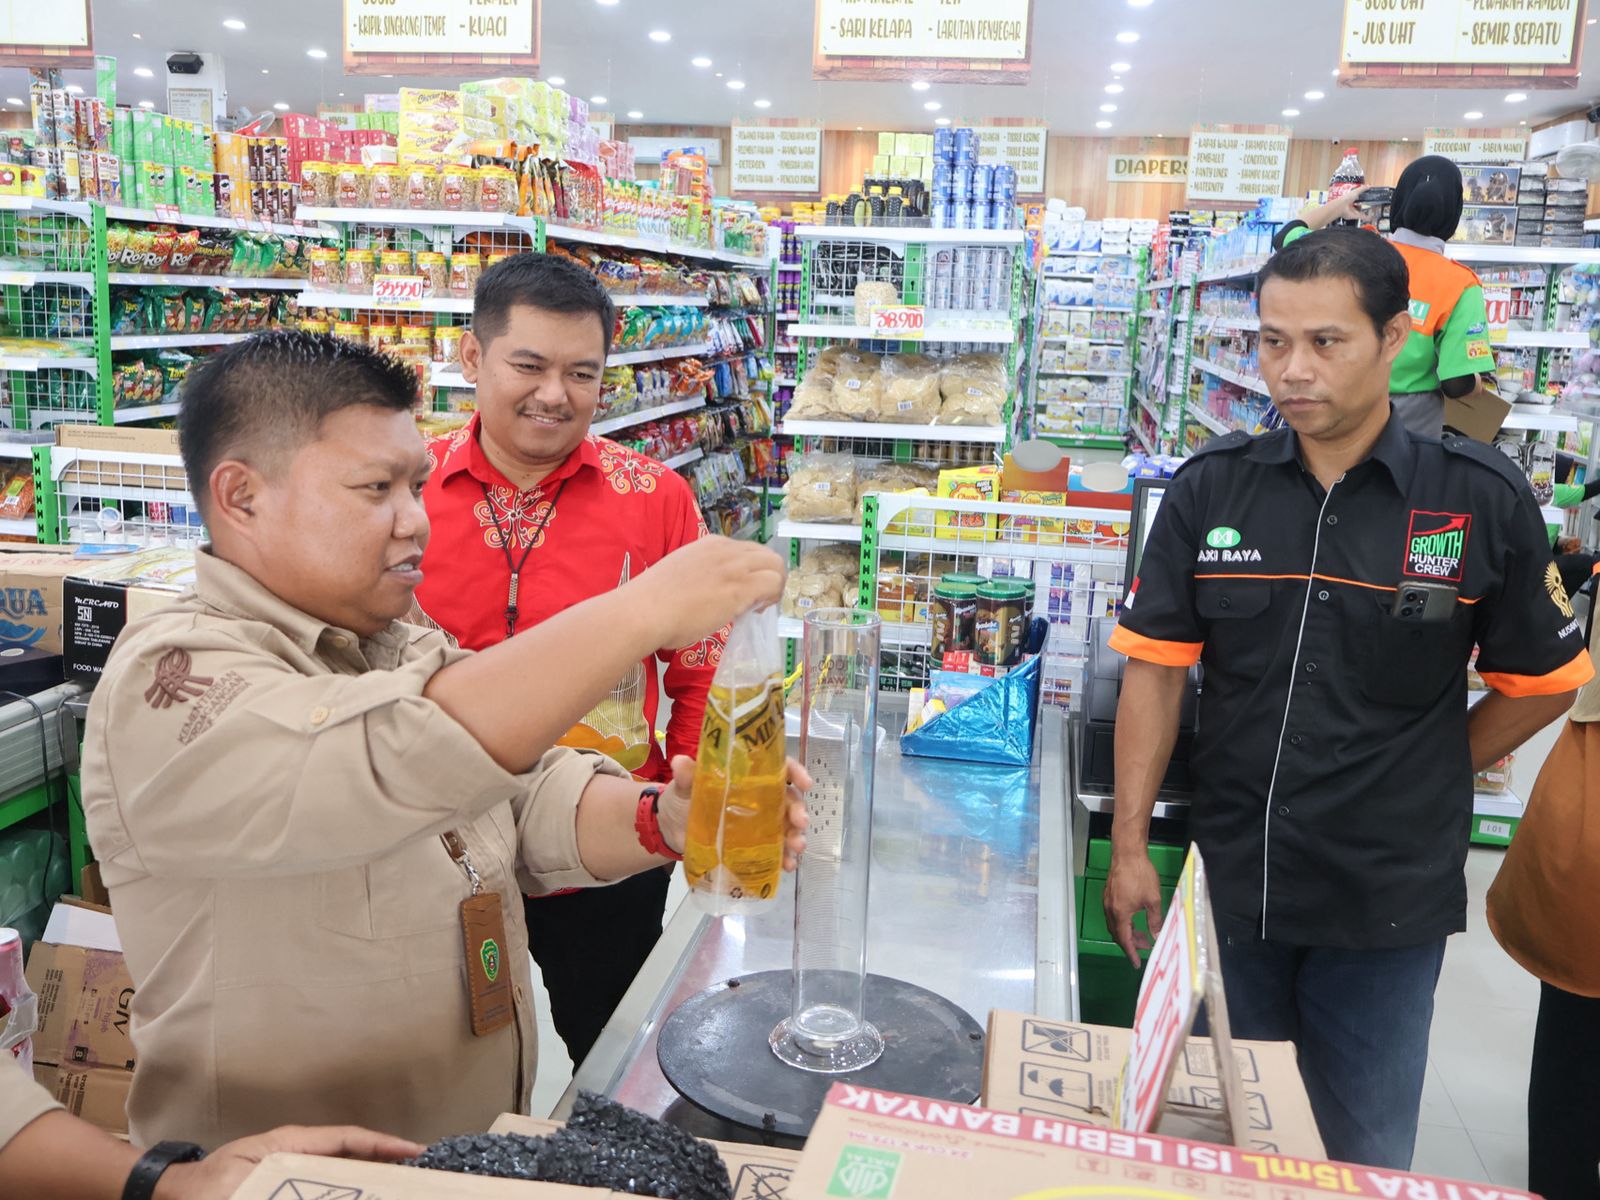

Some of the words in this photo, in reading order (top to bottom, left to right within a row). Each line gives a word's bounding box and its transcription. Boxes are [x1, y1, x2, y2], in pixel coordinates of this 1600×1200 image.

[424, 15, 446, 36] TEMPE
[469, 16, 507, 37] KUACI
[839, 18, 865, 38] SARI
[869, 18, 912, 38] KELAPA
[937, 19, 975, 40] LARUTAN
[977, 20, 1021, 41] PENYEGAR
[1362, 22, 1385, 44] JUS
[1389, 22, 1415, 44] UHT
[1471, 22, 1509, 45] SEMIR
[1513, 22, 1561, 45] SEPATU
[1434, 142, 1471, 152] DEODORANT
[1411, 530, 1463, 558] GROWTH
[1222, 549, 1262, 562] RAYA
[1409, 553, 1459, 569] HUNTER
[1414, 564, 1452, 577] CREW
[77, 605, 92, 622] SNI
[73, 663, 92, 671] FOOD
[113, 987, 135, 1035] GIV
[841, 1083, 1021, 1137] BANYAK
[1031, 1120, 1162, 1166] LEBIH
[1175, 1143, 1234, 1173] ISI
[1241, 1154, 1362, 1194] 15mL
